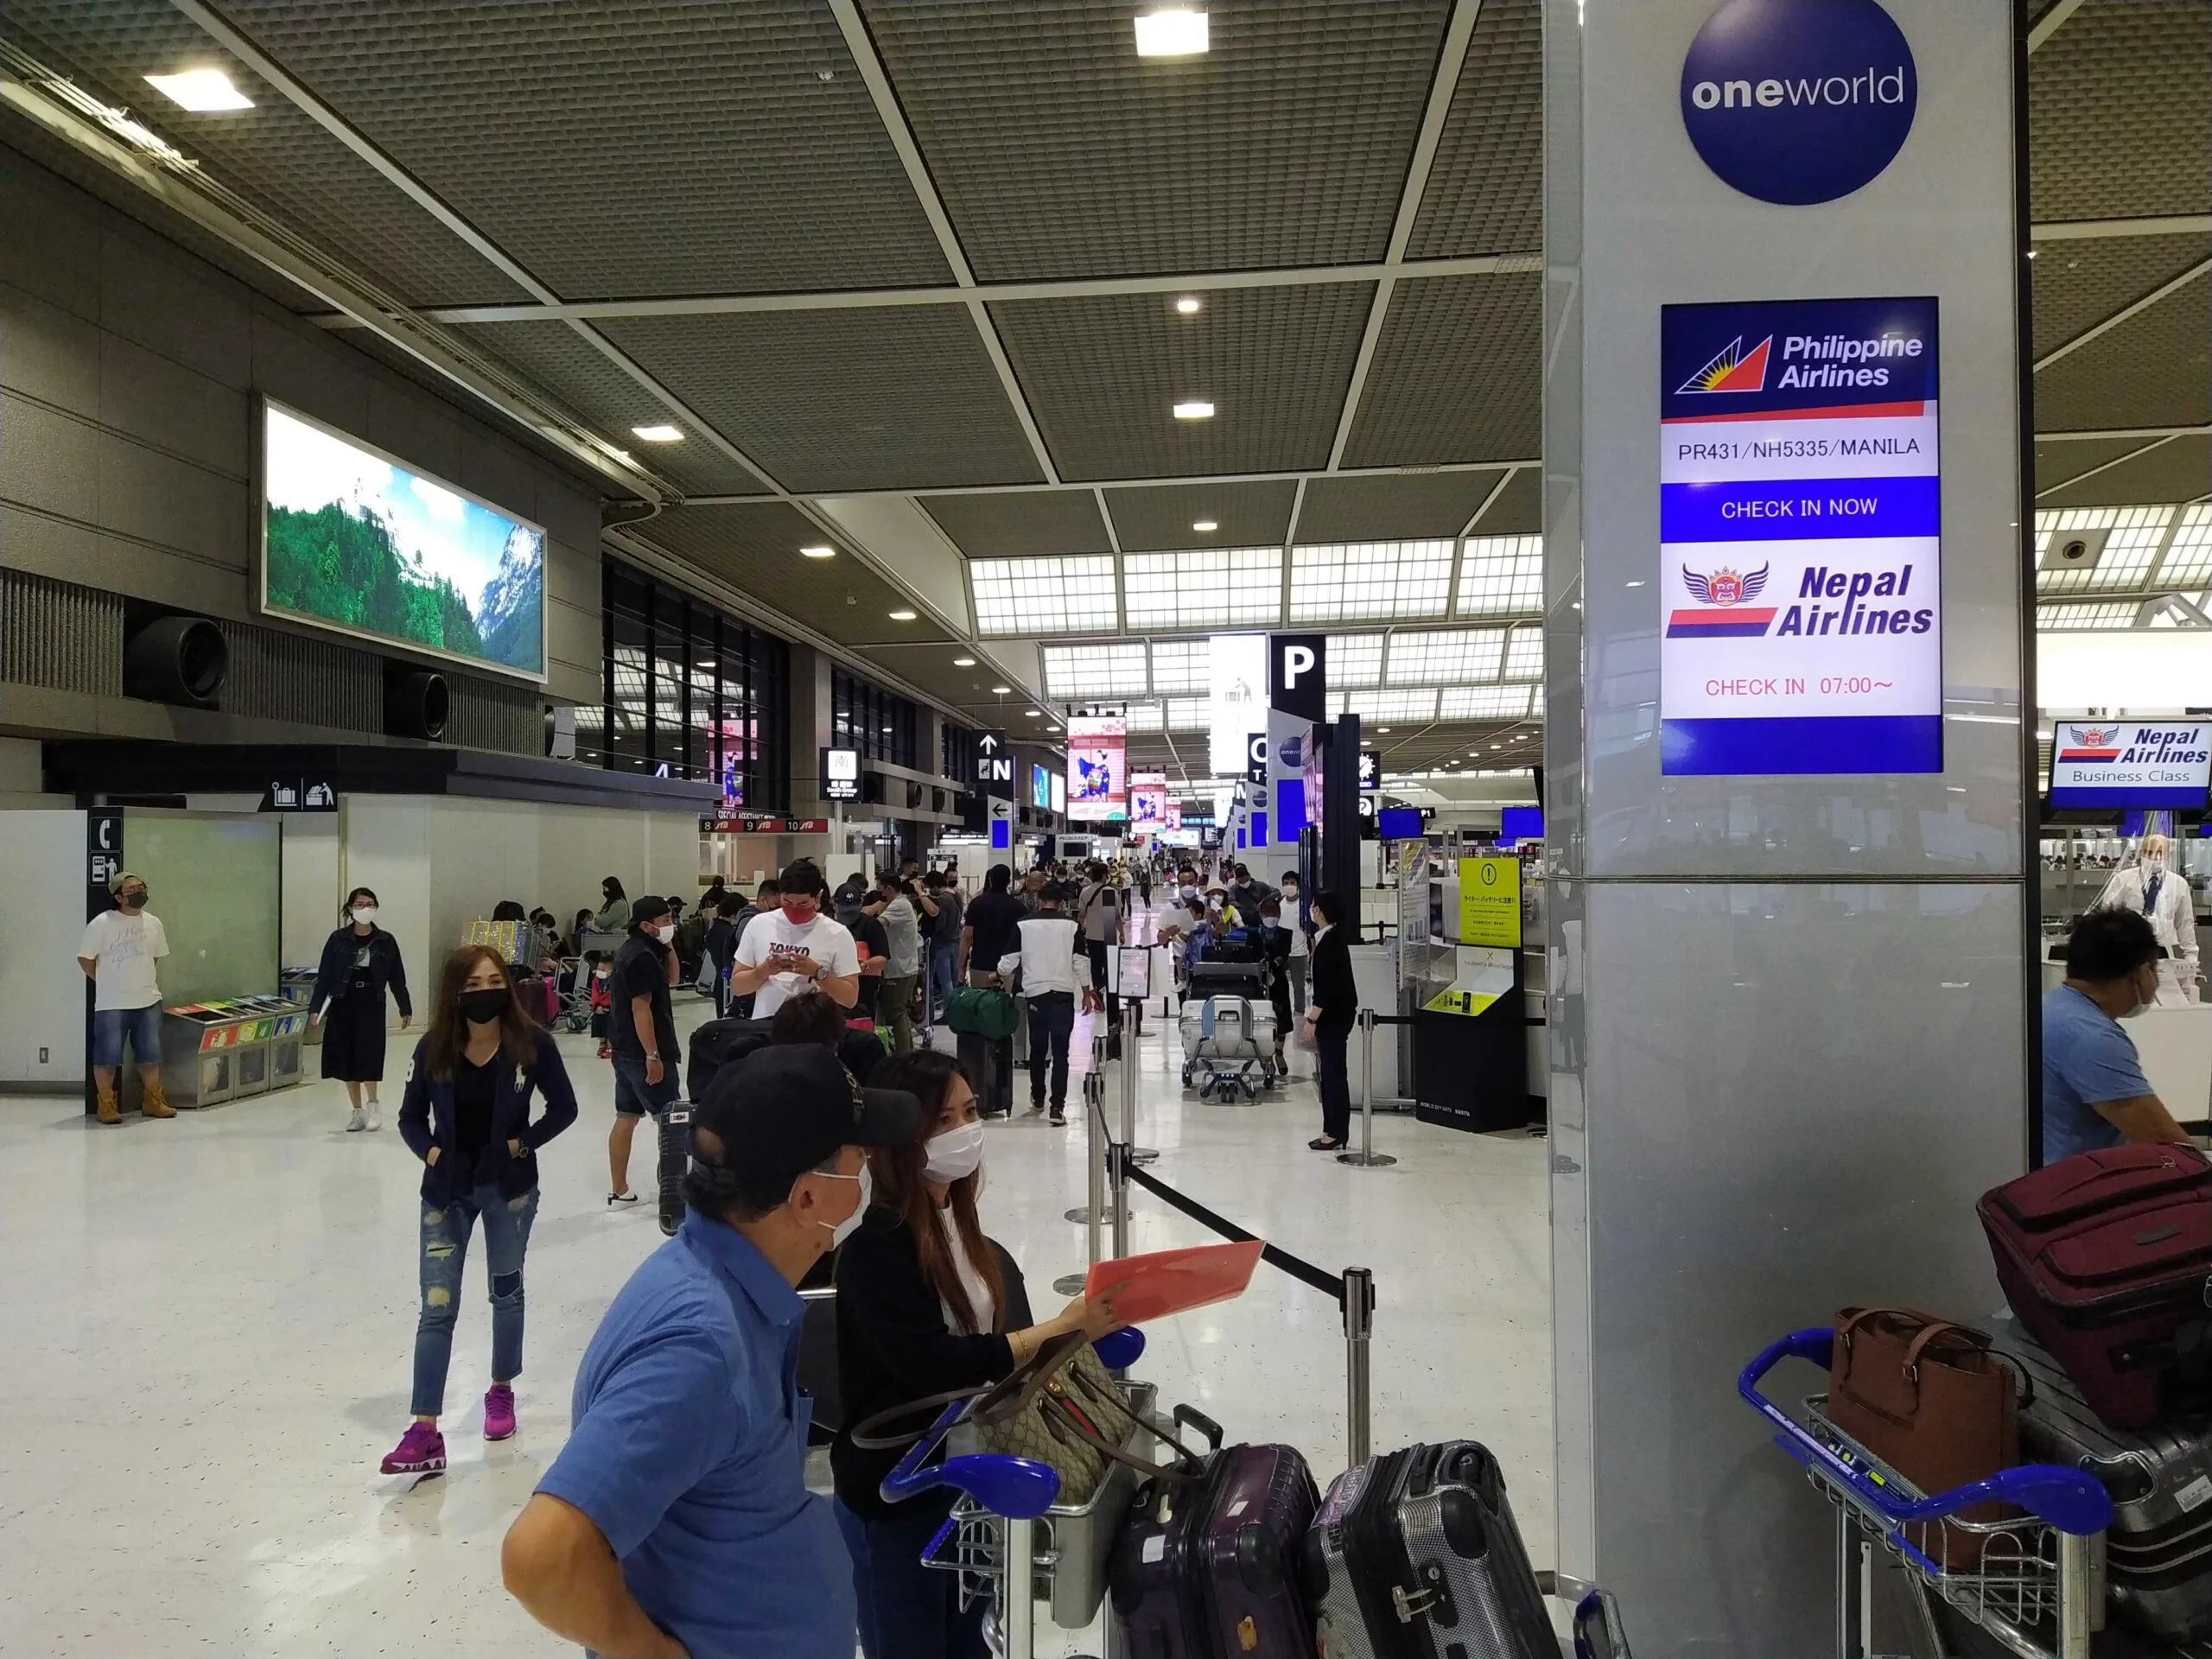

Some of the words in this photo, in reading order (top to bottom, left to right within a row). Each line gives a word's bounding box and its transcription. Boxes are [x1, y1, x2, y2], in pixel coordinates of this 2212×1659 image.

[1691, 66, 1906, 110] oneworld
[1783, 334, 1923, 363] Philippine
[1777, 364, 1890, 389] Airlines
[1678, 437, 1921, 461] PR431/NH5335/MANILA
[1721, 499, 1794, 518] CHECK
[1801, 499, 1821, 517] IN
[1829, 498, 1878, 516] NOW
[1798, 564, 1914, 605] Nepal
[1777, 603, 1934, 637] Airlines
[1284, 645, 1315, 690] P
[1706, 677, 1777, 696] CHECK
[1785, 678, 1805, 695] IN
[2134, 728, 2200, 747] Nepal
[2120, 747, 2209, 764] Airlines
[993, 760, 1010, 780] N
[2073, 770, 2142, 782] Business
[2148, 770, 2190, 782] Class
[704, 822, 711, 830] 8
[747, 822, 753, 830] 9
[788, 822, 798, 830] 10
